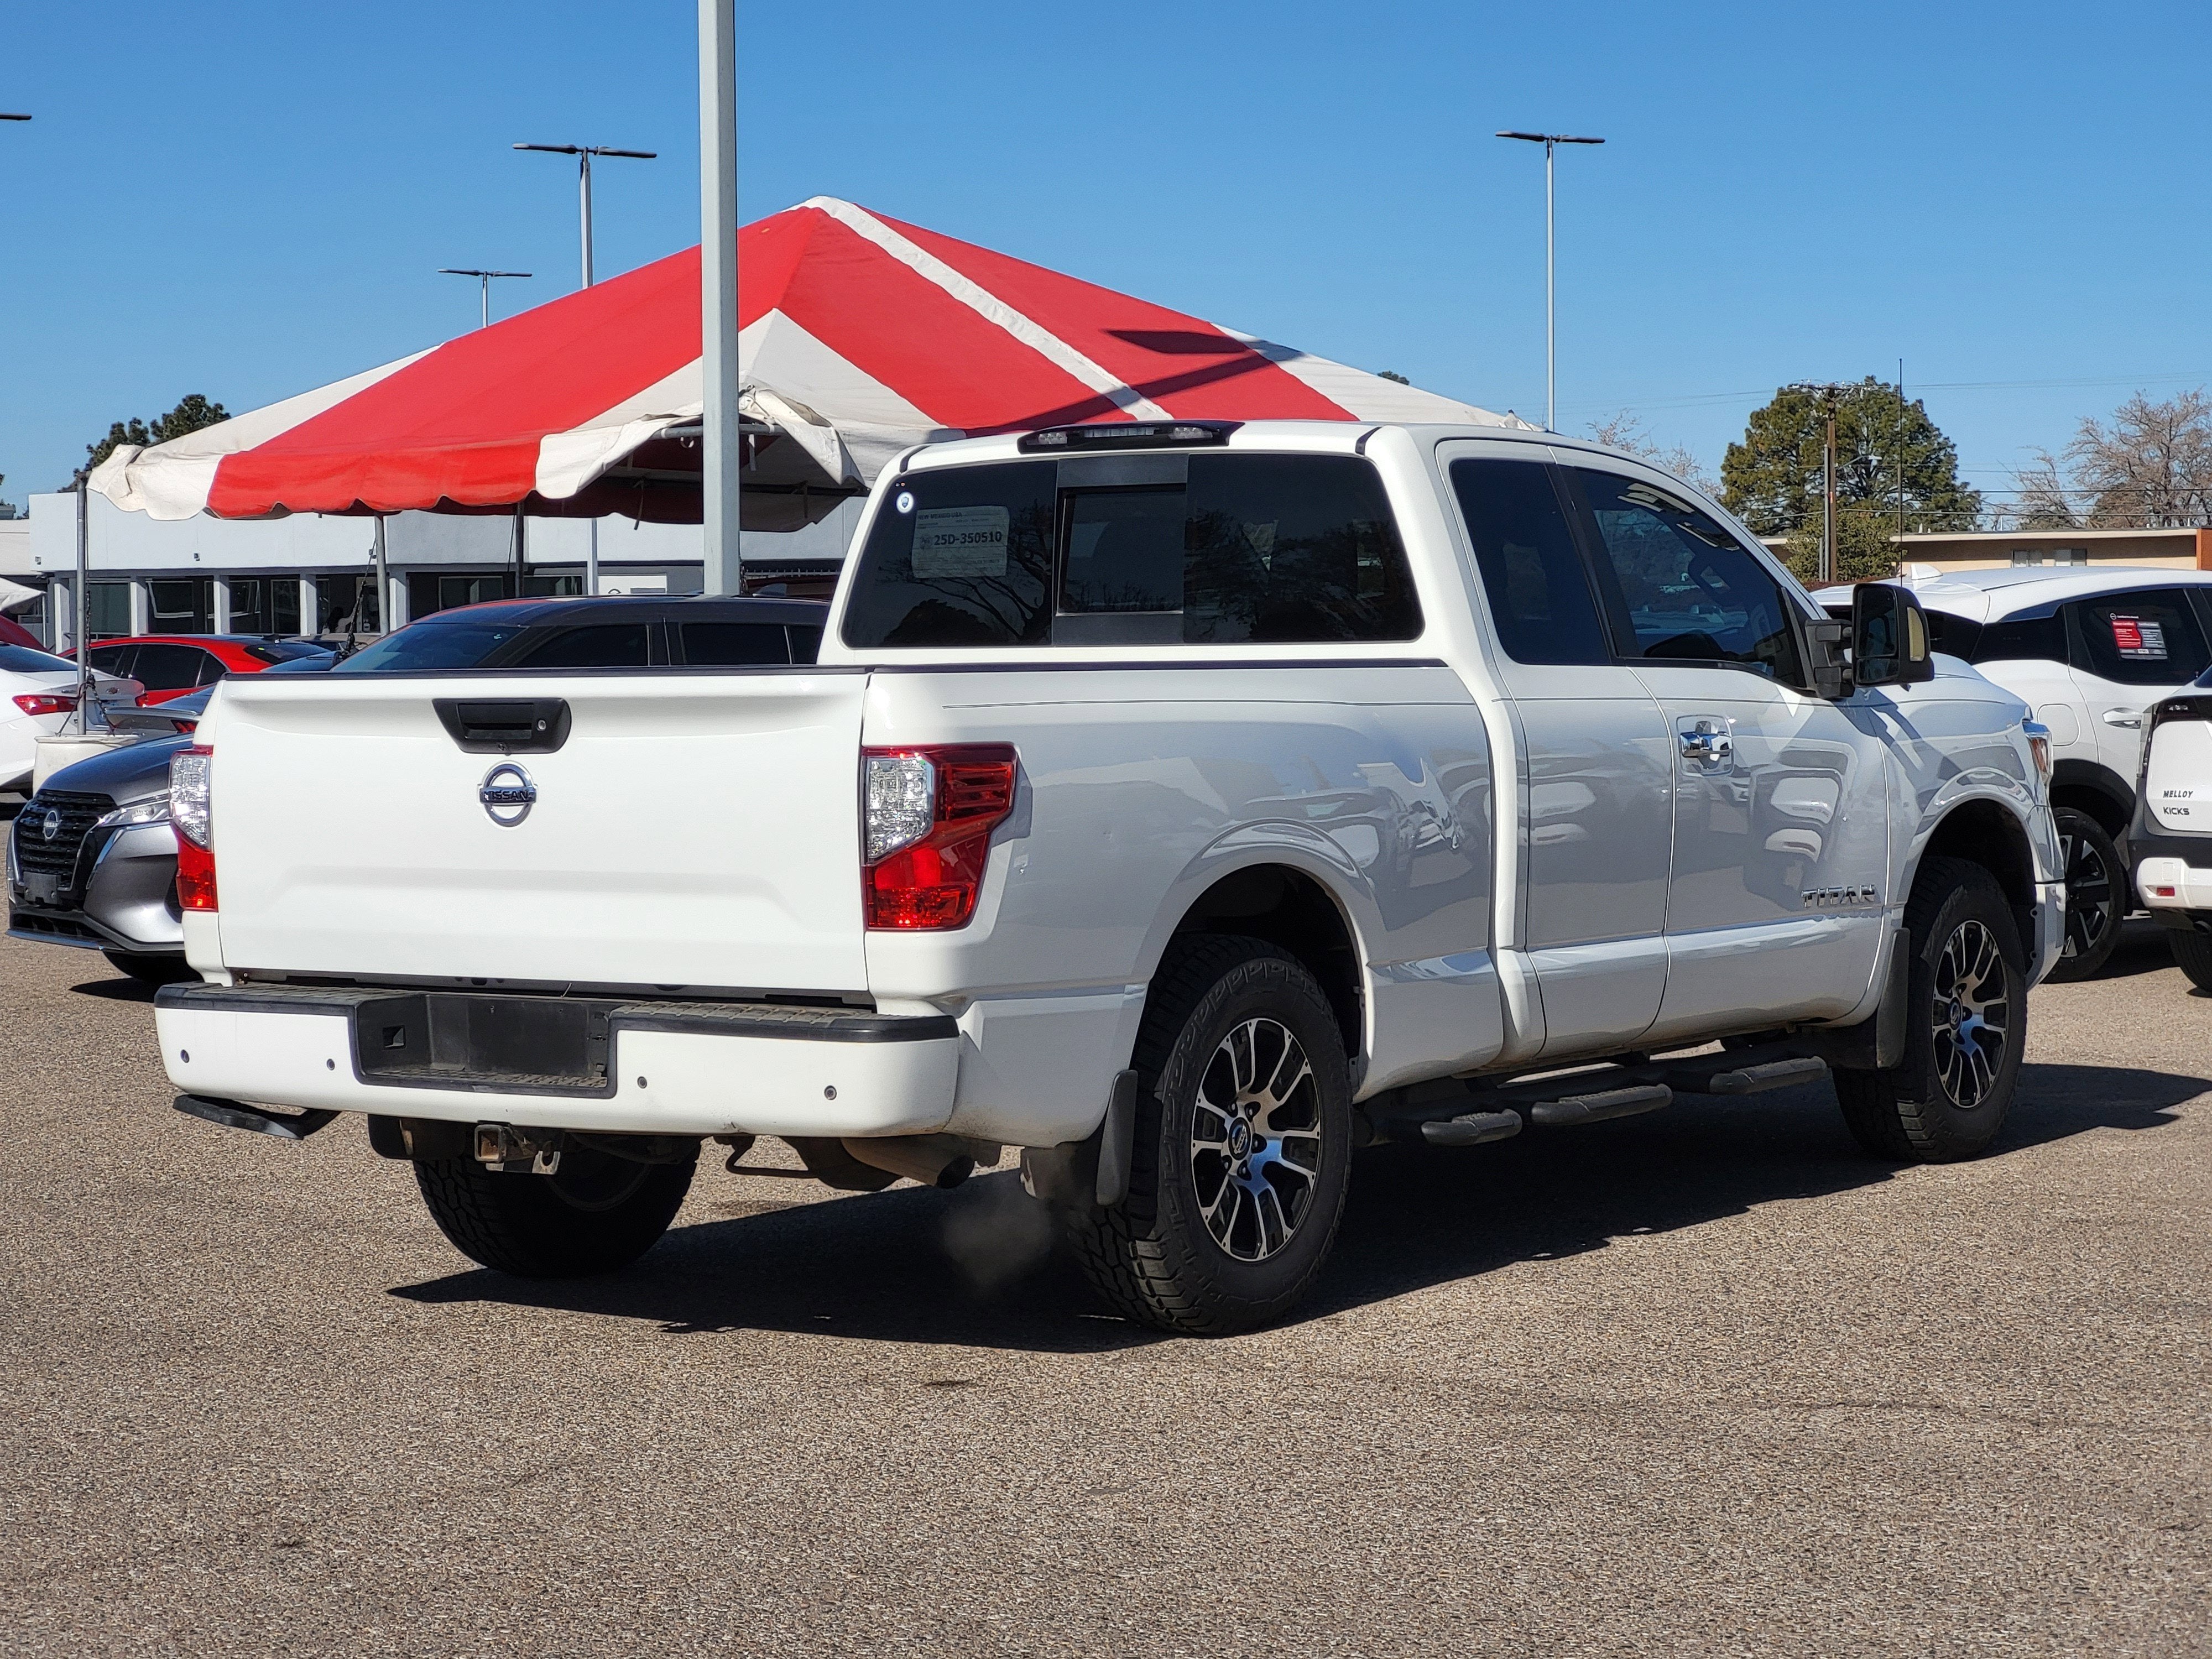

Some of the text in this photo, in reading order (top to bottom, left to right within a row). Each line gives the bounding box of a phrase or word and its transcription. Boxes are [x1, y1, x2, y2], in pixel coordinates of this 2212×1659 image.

[934, 531, 1002, 546] 25D-350510
[484, 790, 528, 801] NISSAN
[2163, 790, 2194, 798] MELLOY
[2163, 806, 2190, 815] KICKS
[1801, 884, 1875, 908] TITAN
